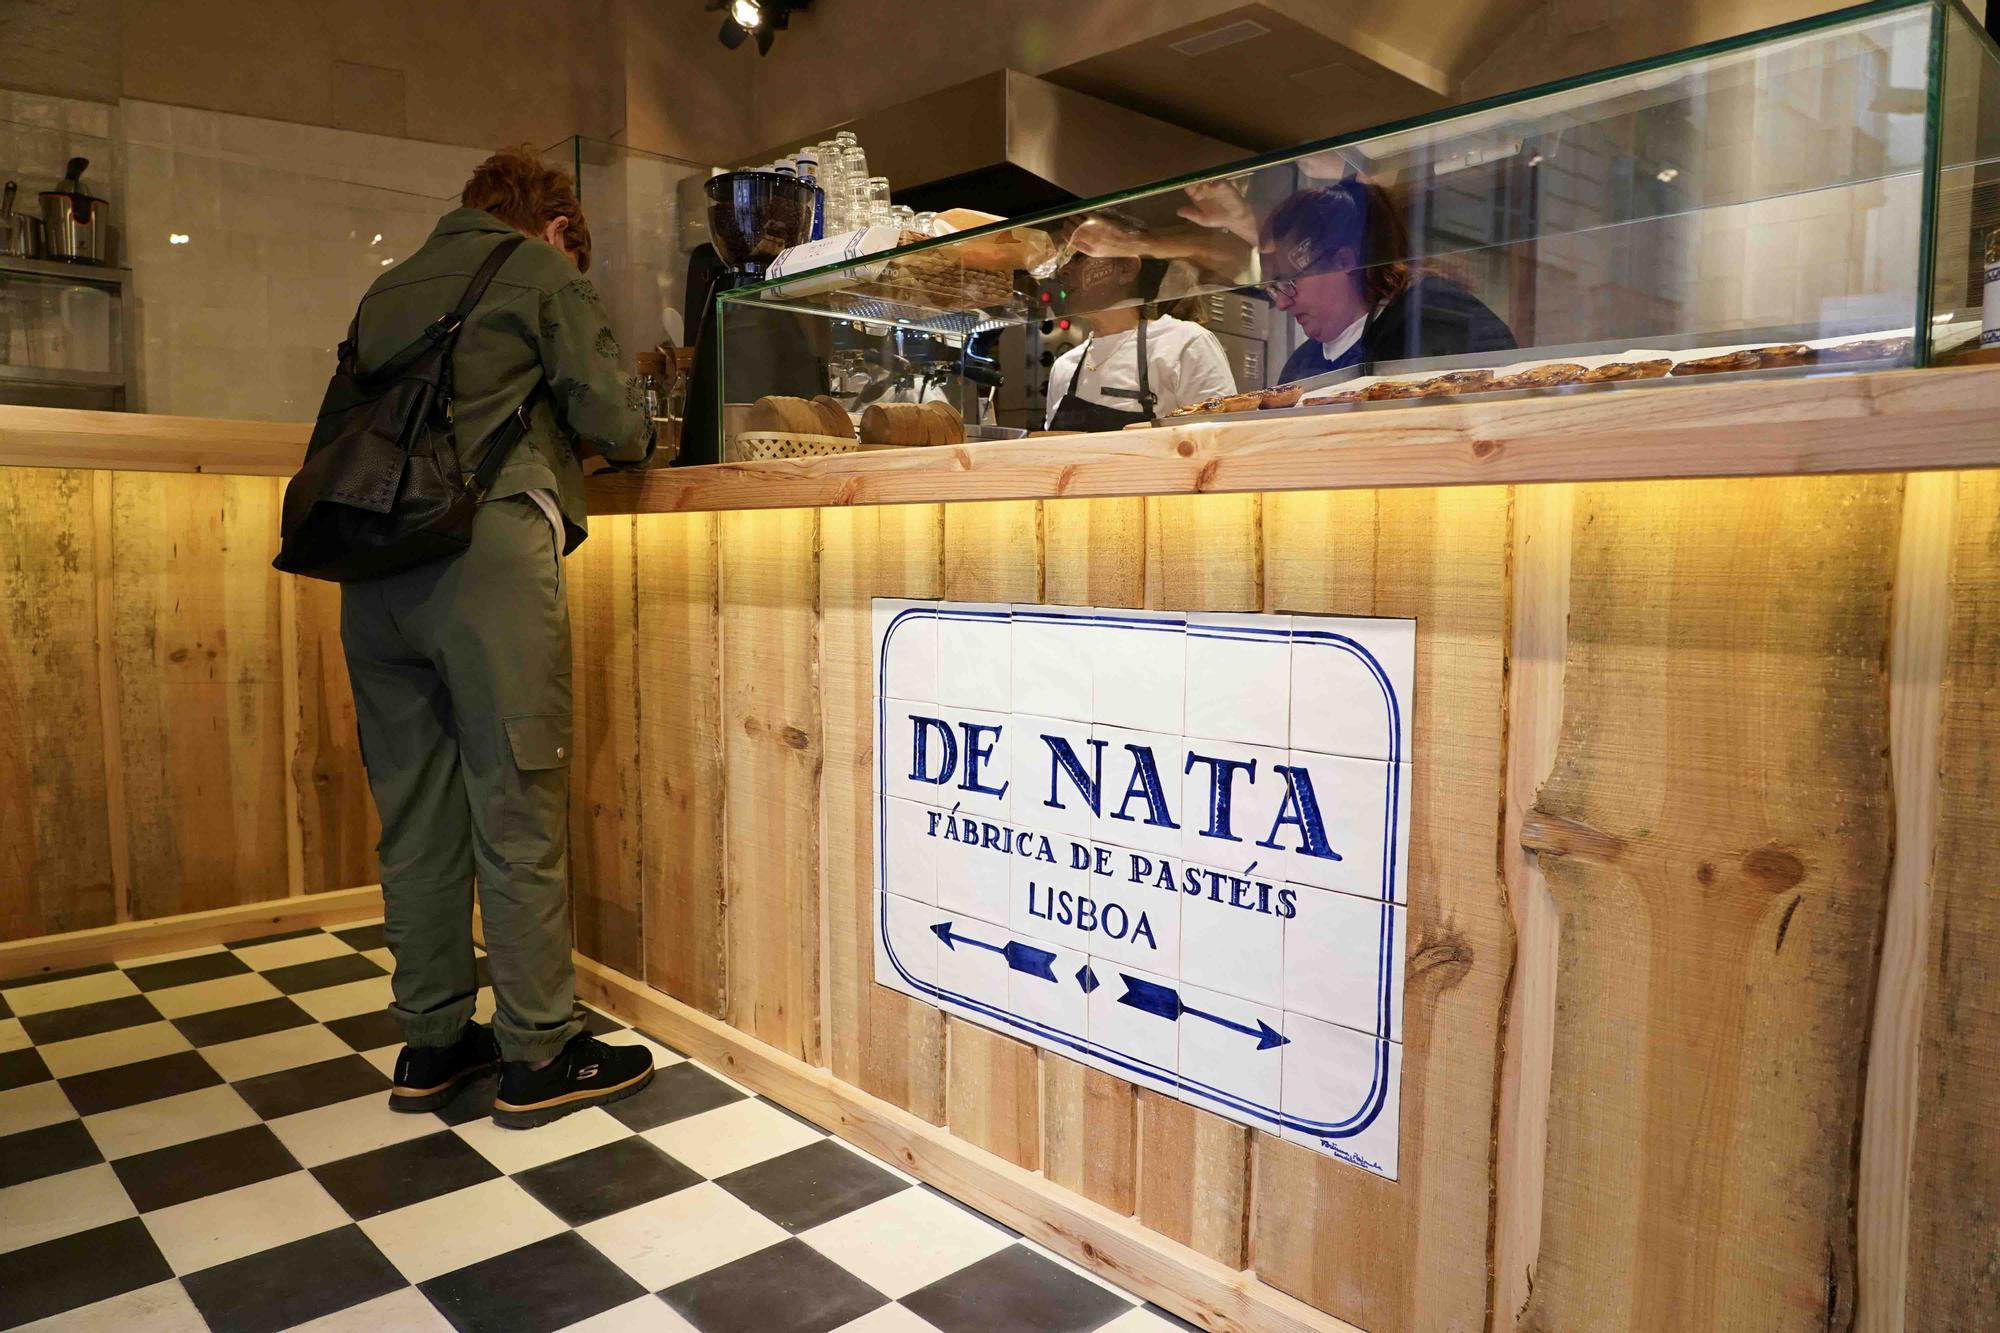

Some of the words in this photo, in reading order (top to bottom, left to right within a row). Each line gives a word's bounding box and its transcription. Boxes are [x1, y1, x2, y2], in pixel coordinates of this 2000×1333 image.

[908, 714, 1009, 800] DE
[1040, 734, 1342, 862] NATA
[927, 801, 1057, 863] FÁBRICA
[1070, 843, 1114, 877] DE
[1128, 854, 1297, 919] PASTÉIS
[1029, 882, 1157, 951] LISBOA
